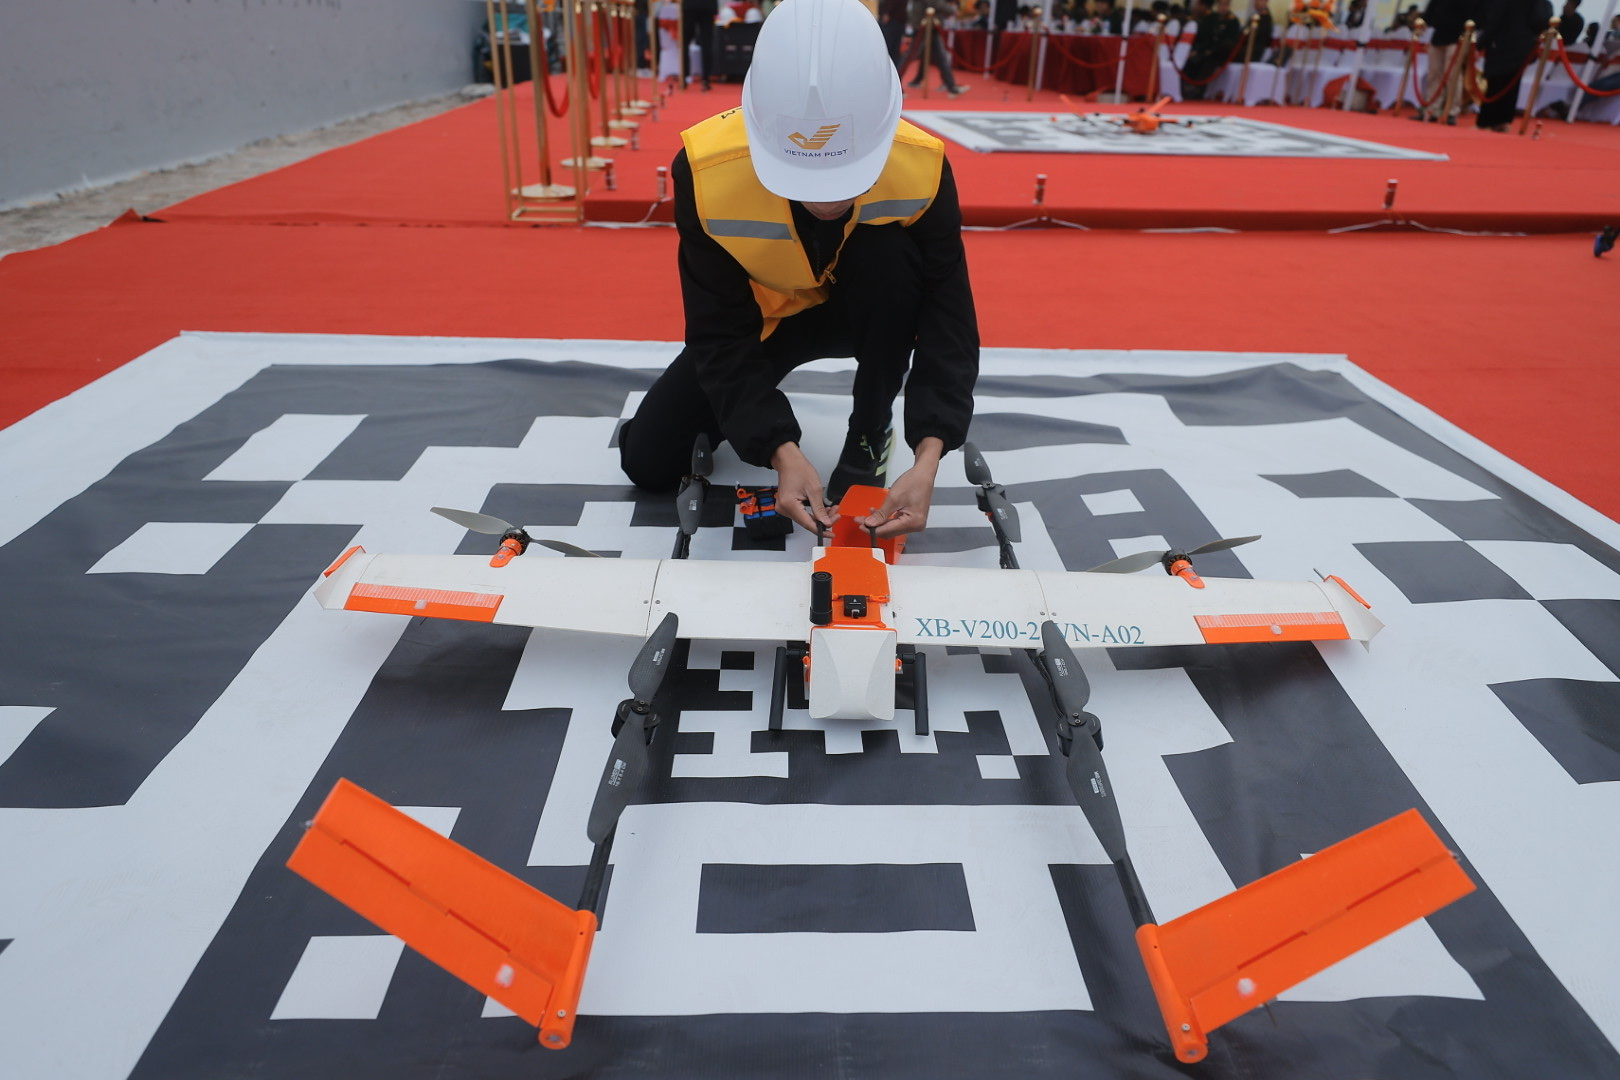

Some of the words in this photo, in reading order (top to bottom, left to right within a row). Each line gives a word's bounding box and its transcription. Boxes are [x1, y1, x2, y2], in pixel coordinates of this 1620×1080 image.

[784, 148, 822, 158] VIETNAM
[824, 148, 849, 157] POST
[915, 617, 1145, 645] XB-V200-2VN-A02
